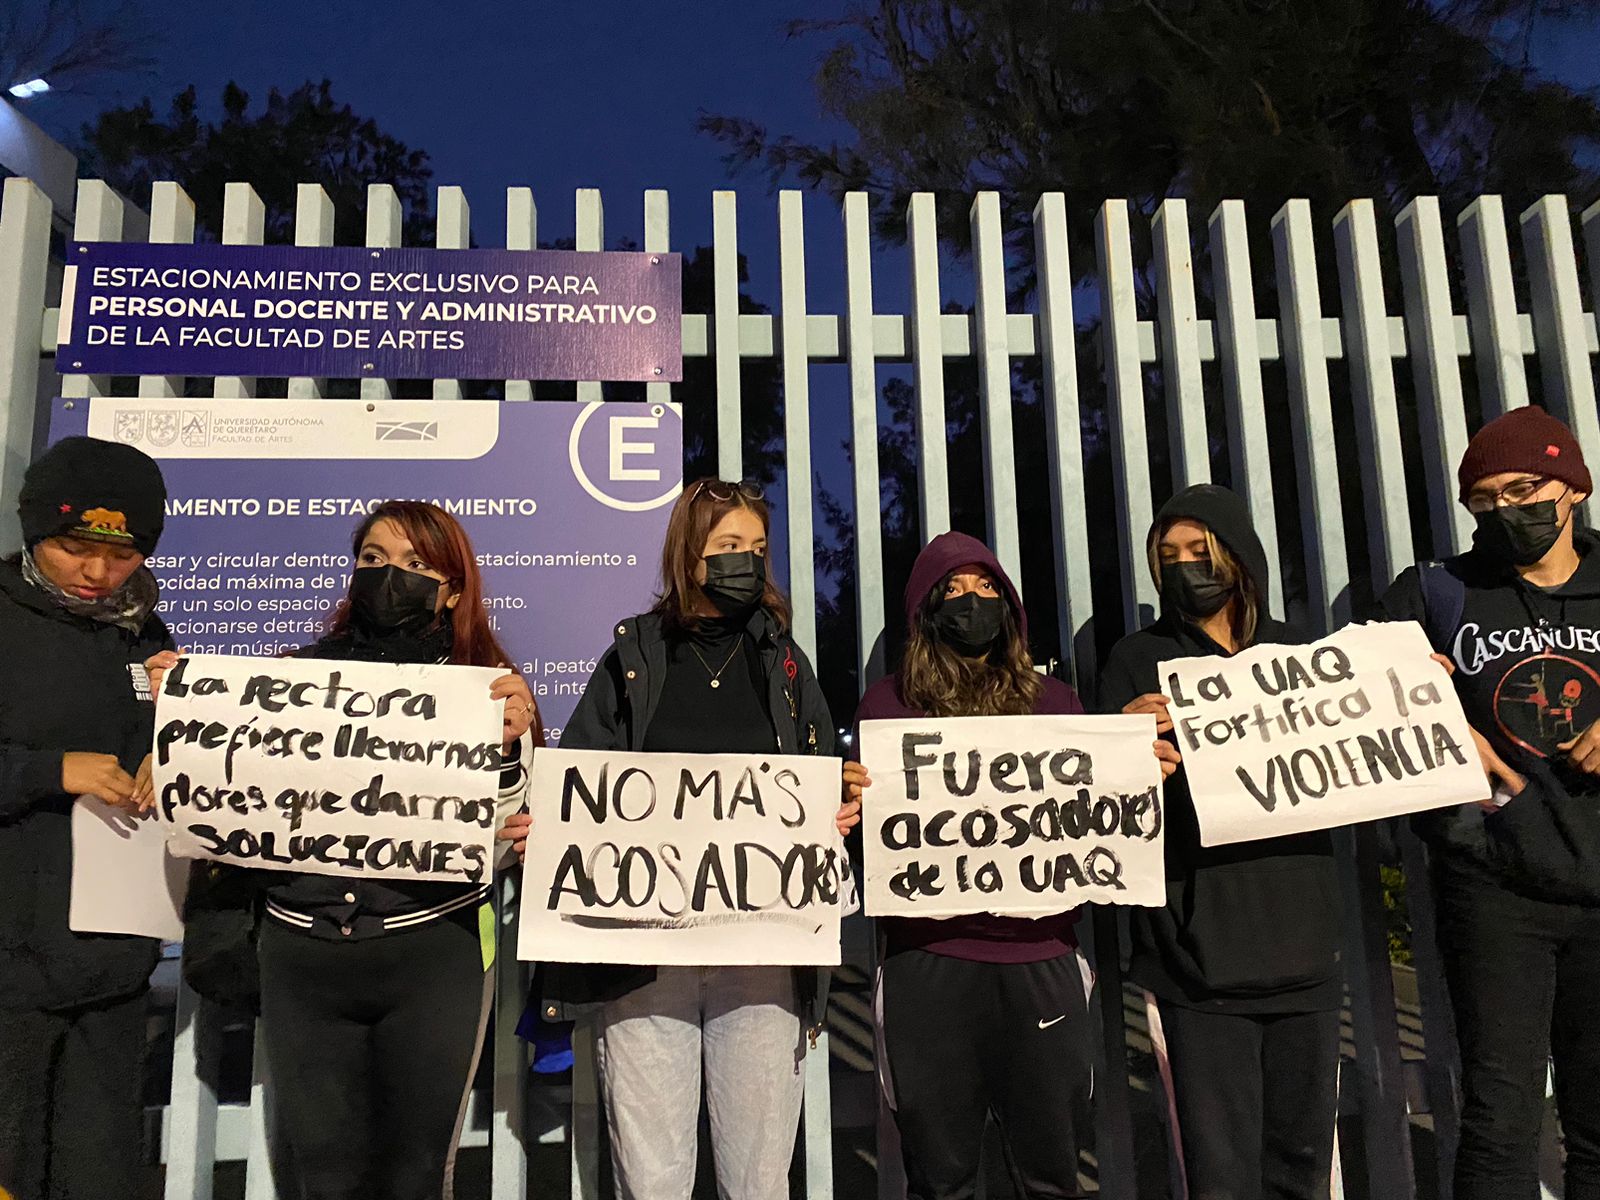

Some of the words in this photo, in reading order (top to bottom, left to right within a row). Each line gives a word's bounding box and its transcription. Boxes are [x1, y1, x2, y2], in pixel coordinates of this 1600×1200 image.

[93, 267, 361, 291] ESTACIONAMIENTO
[370, 272, 519, 294] EXCLUSIVO
[527, 275, 599, 295] PARA
[89, 296, 245, 318] PERSONAL
[254, 299, 388, 320] DOCENTE
[396, 301, 415, 321] Y
[420, 302, 657, 325] ADMINISTRATIVO
[87, 325, 126, 345] DE
[135, 326, 170, 346] LA
[179, 327, 324, 348] FACULTAD
[333, 329, 370, 349] DE
[377, 329, 464, 350] ARTES
[214, 418, 270, 426] UNIVERSIDAD
[164, 498, 261, 516] AMENTO
[267, 498, 300, 516] DE
[307, 497, 537, 516] ESTACAMIENTO
[144, 555, 186, 568] esar
[189, 555, 202, 571] y
[206, 552, 279, 568] circular
[285, 552, 349, 568] dentro
[475, 551, 622, 566] stacionamiento
[626, 554, 637, 566] a
[156, 574, 221, 590] ocidad
[226, 574, 305, 590] máxima
[311, 574, 335, 589] de
[183, 600, 207, 612] un
[213, 596, 252, 612] solo
[257, 596, 330, 614] espacio
[165, 618, 258, 634] acionarse
[263, 617, 324, 634] detrás
[523, 658, 538, 674] al
[544, 657, 597, 677] peató
[1168, 672, 1232, 708] La
[1251, 645, 1355, 696] UAQ
[164, 658, 229, 698] La
[239, 671, 436, 720] rectora
[533, 680, 548, 695] la
[1180, 687, 1371, 751] Fortifica
[1386, 667, 1442, 718] la
[333, 724, 503, 772] llevarnos
[901, 731, 1093, 800] Fuera
[1235, 722, 1467, 812] VIOLENCIA
[560, 761, 657, 824] NO
[275, 787, 346, 832] que
[187, 824, 487, 882] SOLUCIONES
[888, 861, 945, 901] de
[956, 854, 1004, 893] la
[1019, 846, 1127, 894] UAQ
